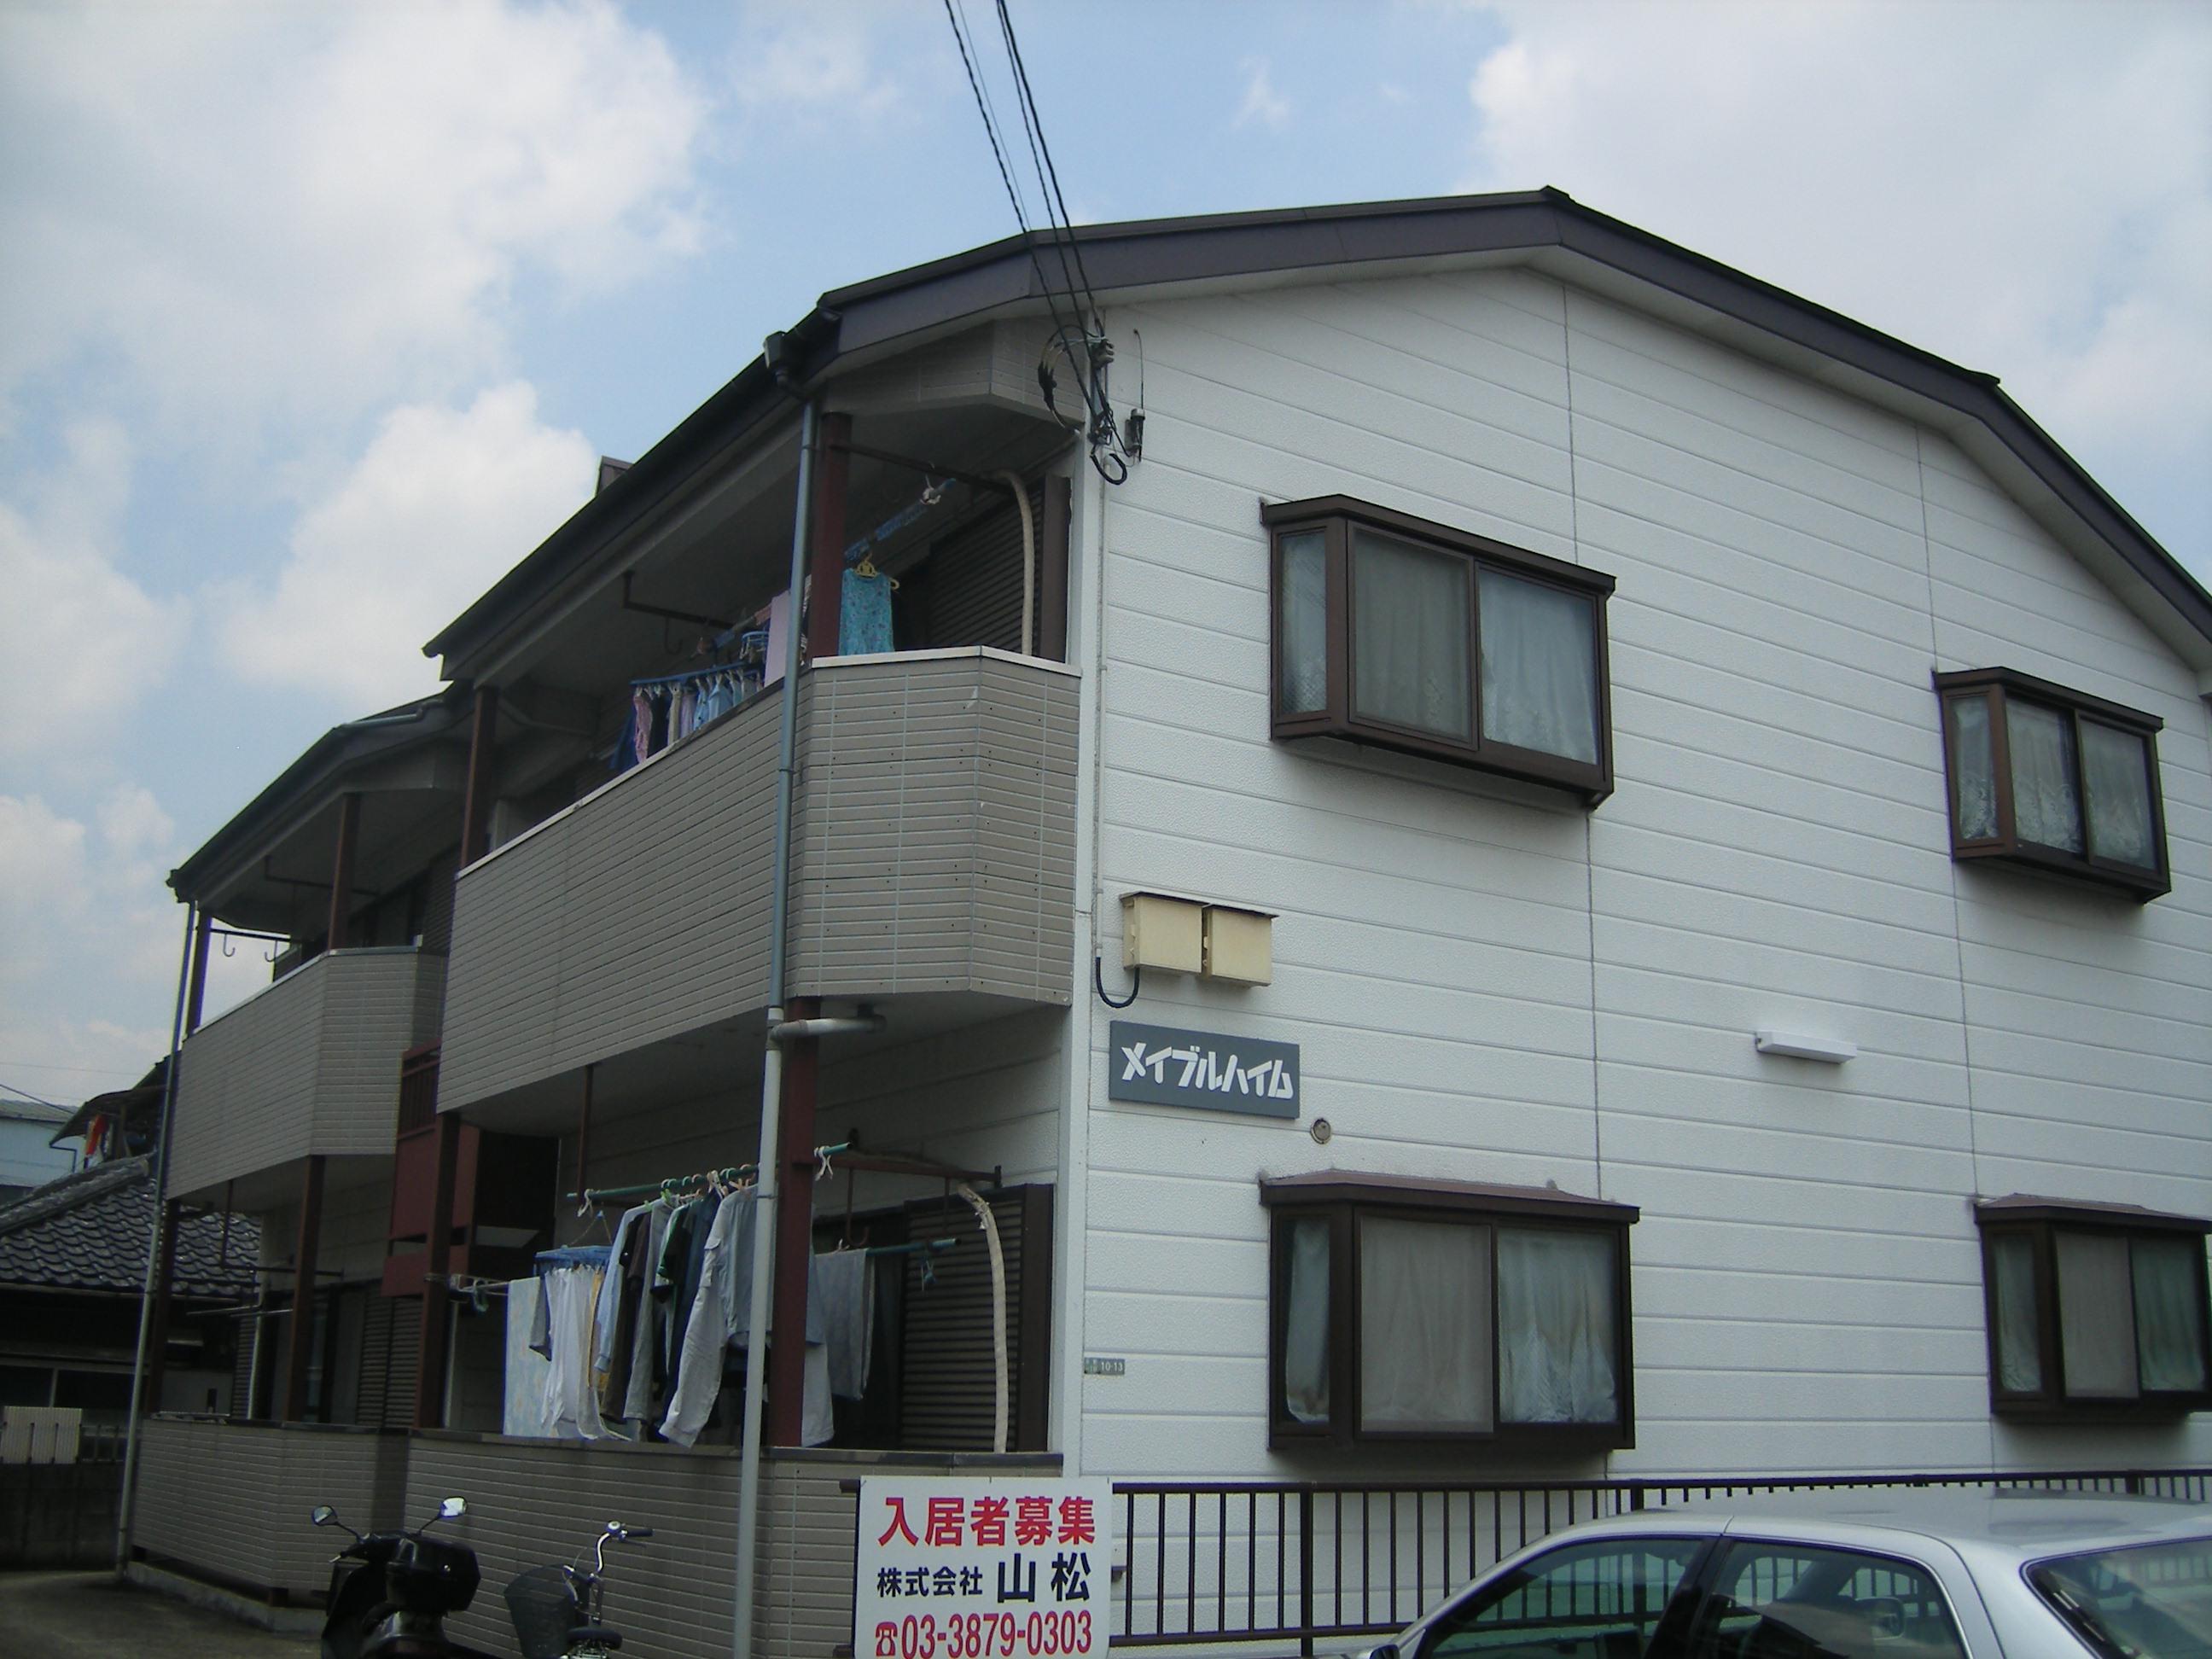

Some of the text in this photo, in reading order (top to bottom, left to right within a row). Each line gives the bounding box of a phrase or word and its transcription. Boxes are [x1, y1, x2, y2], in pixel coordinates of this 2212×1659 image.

[1120, 1041, 1294, 1100] メイブルハイム
[1101, 1361, 1124, 1372] 10-13
[877, 1495, 1096, 1547] 入居者募集
[876, 1551, 1091, 1604] 株式会社 山松
[901, 1610, 1092, 1659] 03-3879-0303
